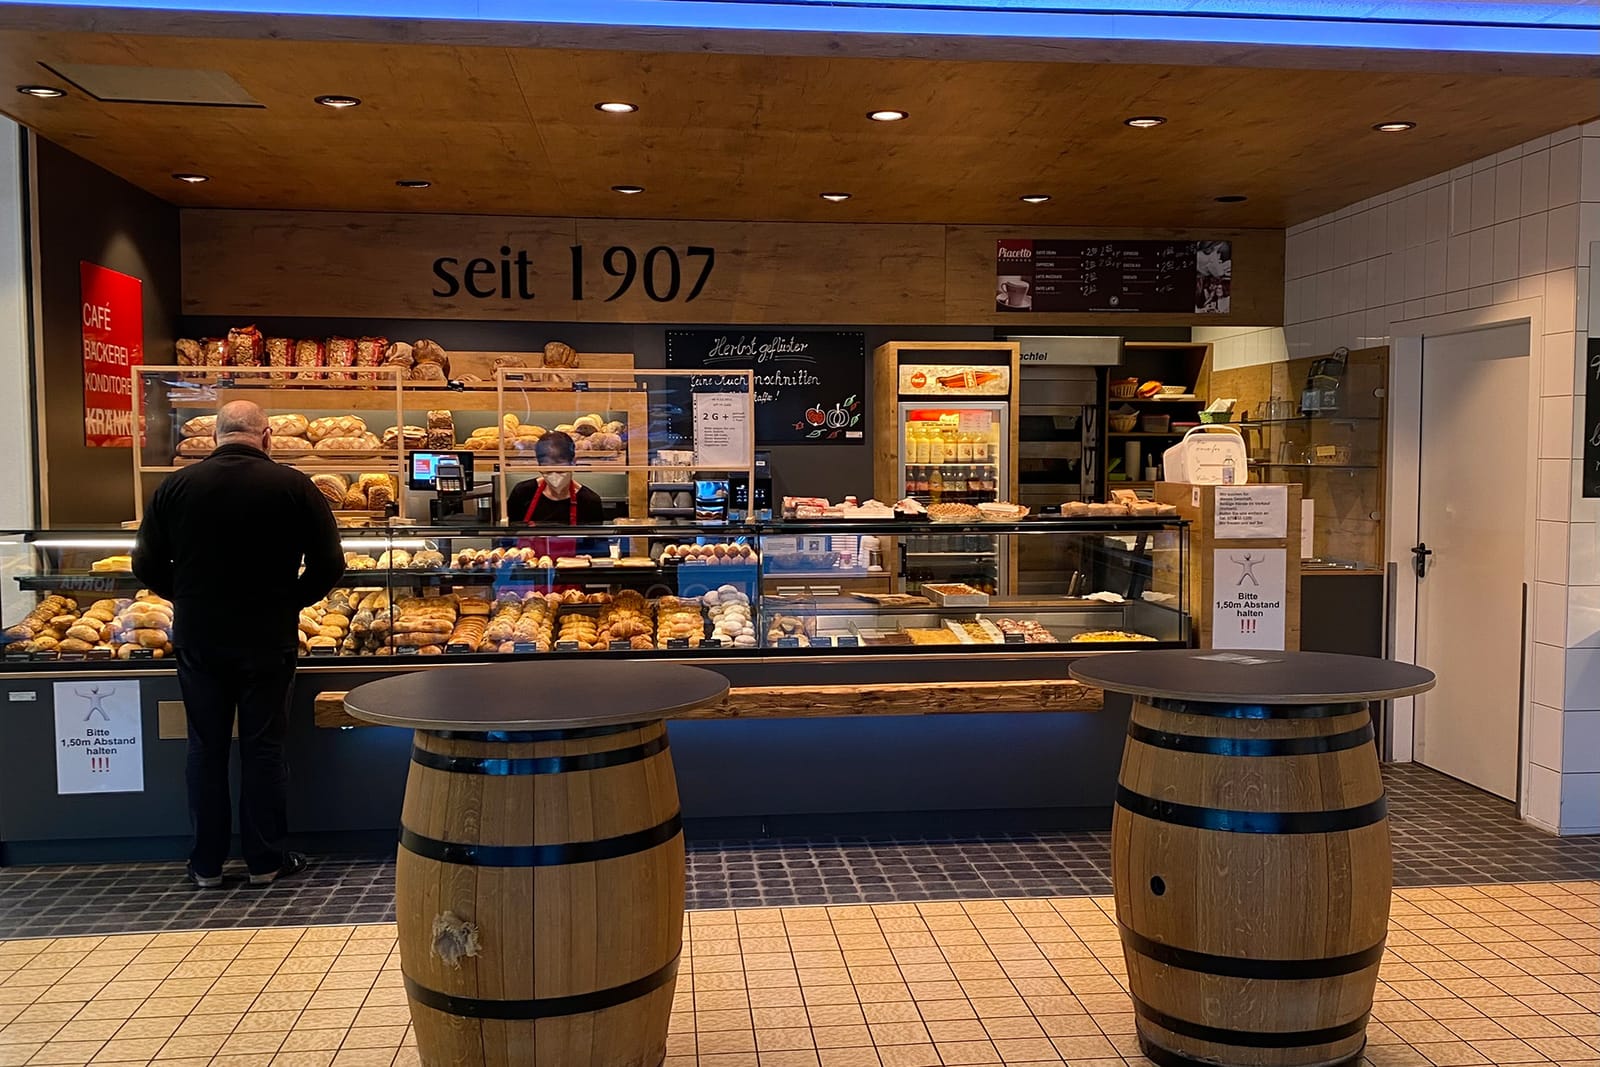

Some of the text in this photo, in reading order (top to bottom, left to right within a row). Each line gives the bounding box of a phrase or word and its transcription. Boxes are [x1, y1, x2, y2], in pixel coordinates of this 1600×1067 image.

[997, 247, 1032, 258] Piacetto
[432, 245, 716, 303] seit 1907
[83, 302, 112, 331] CAFÉ
[708, 336, 757, 357] Herbst
[84, 339, 129, 366] BÄCKEREI
[85, 372, 132, 395] KONDITORE
[85, 408, 134, 436] KRÄNK
[703, 413, 709, 421] 2
[712, 413, 719, 421] G
[1238, 592, 1258, 600] Bitte
[1216, 601, 1280, 610] 1,50m Abstand
[1236, 609, 1264, 617] halten
[86, 729, 110, 737] Bitte
[60, 737, 136, 748] 1,50m Abstand
[86, 747, 117, 755] halten
